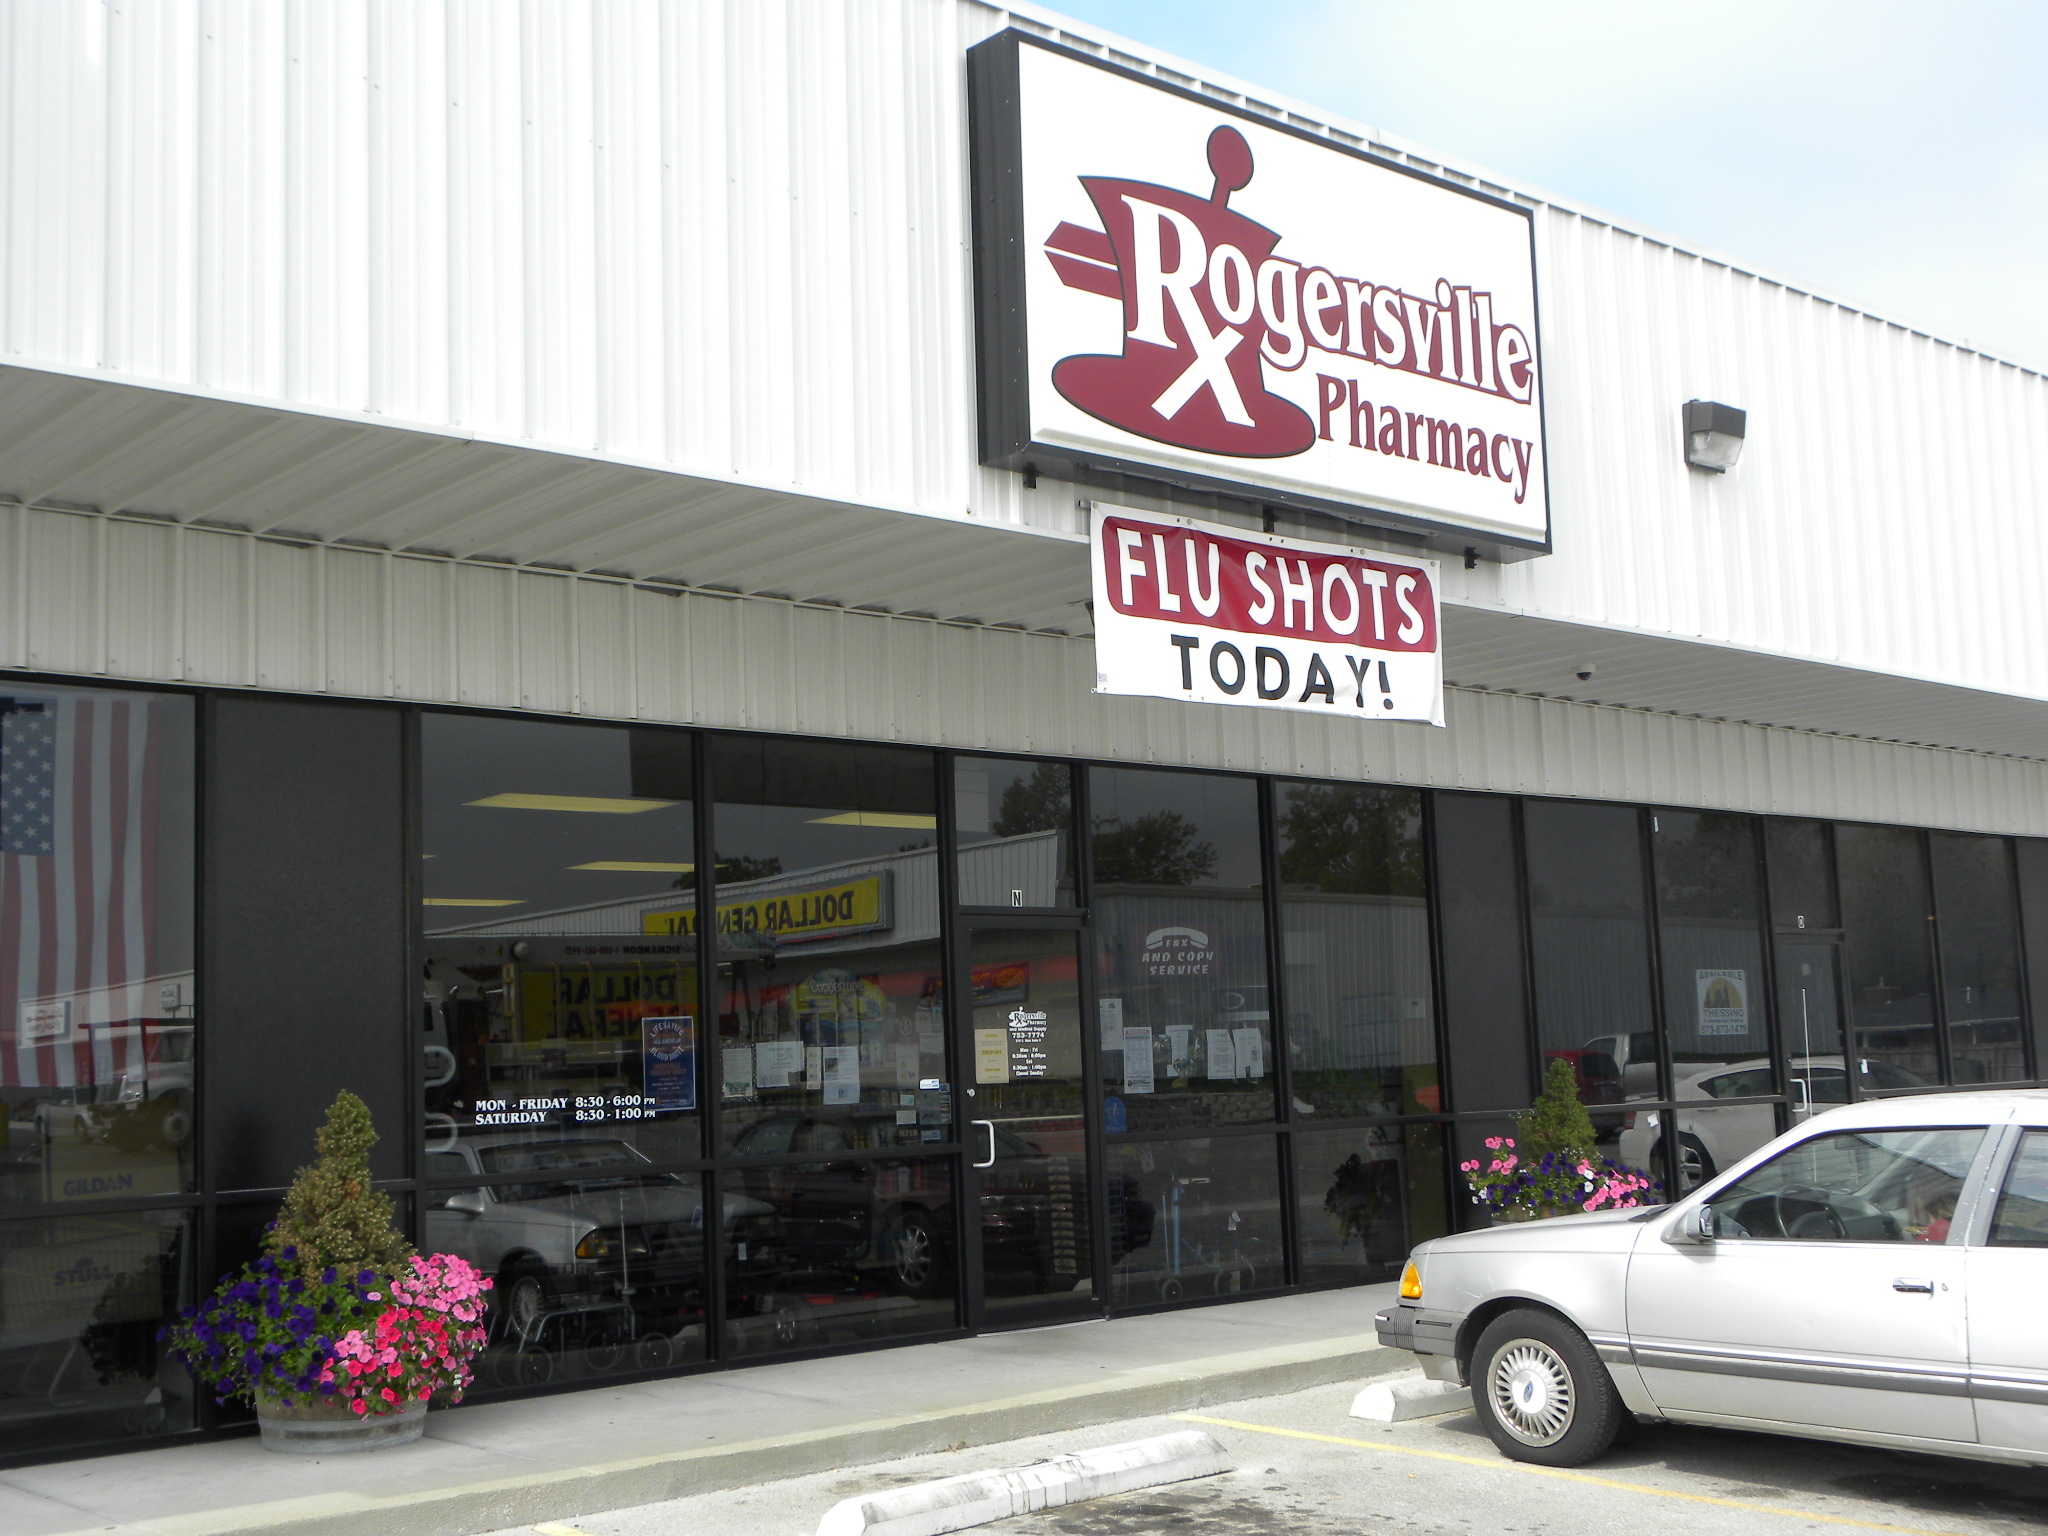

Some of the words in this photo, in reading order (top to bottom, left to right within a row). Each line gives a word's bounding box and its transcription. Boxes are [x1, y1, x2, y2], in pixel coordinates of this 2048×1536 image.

[1120, 193, 1534, 426] Rogersville
[1315, 372, 1534, 504] Pharmacy
[1116, 527, 1221, 618] FLU
[1245, 551, 1425, 645] SHOTS
[1170, 633, 1394, 711] TODAY!
[1012, 891, 1021, 906] N
[1165, 938, 1188, 948] FAX
[1142, 951, 1171, 962] AND
[1177, 951, 1214, 962] COPY
[1149, 964, 1209, 976] SERVICE
[1699, 971, 1744, 981] AVAILABLE
[1704, 1008, 1744, 1017] THESSING
[475, 1099, 507, 1112] MON
[518, 1097, 569, 1111] FRIDAY
[574, 1095, 604, 1108] 8:30
[612, 1094, 642, 1107] 6:00
[644, 1097, 656, 1105] PM
[475, 1111, 547, 1126] SATURDAY
[575, 1109, 605, 1122] 8:30
[614, 1108, 642, 1120] 1:00
[644, 1111, 656, 1119] PM
[63, 1174, 133, 1196] GILDAN
